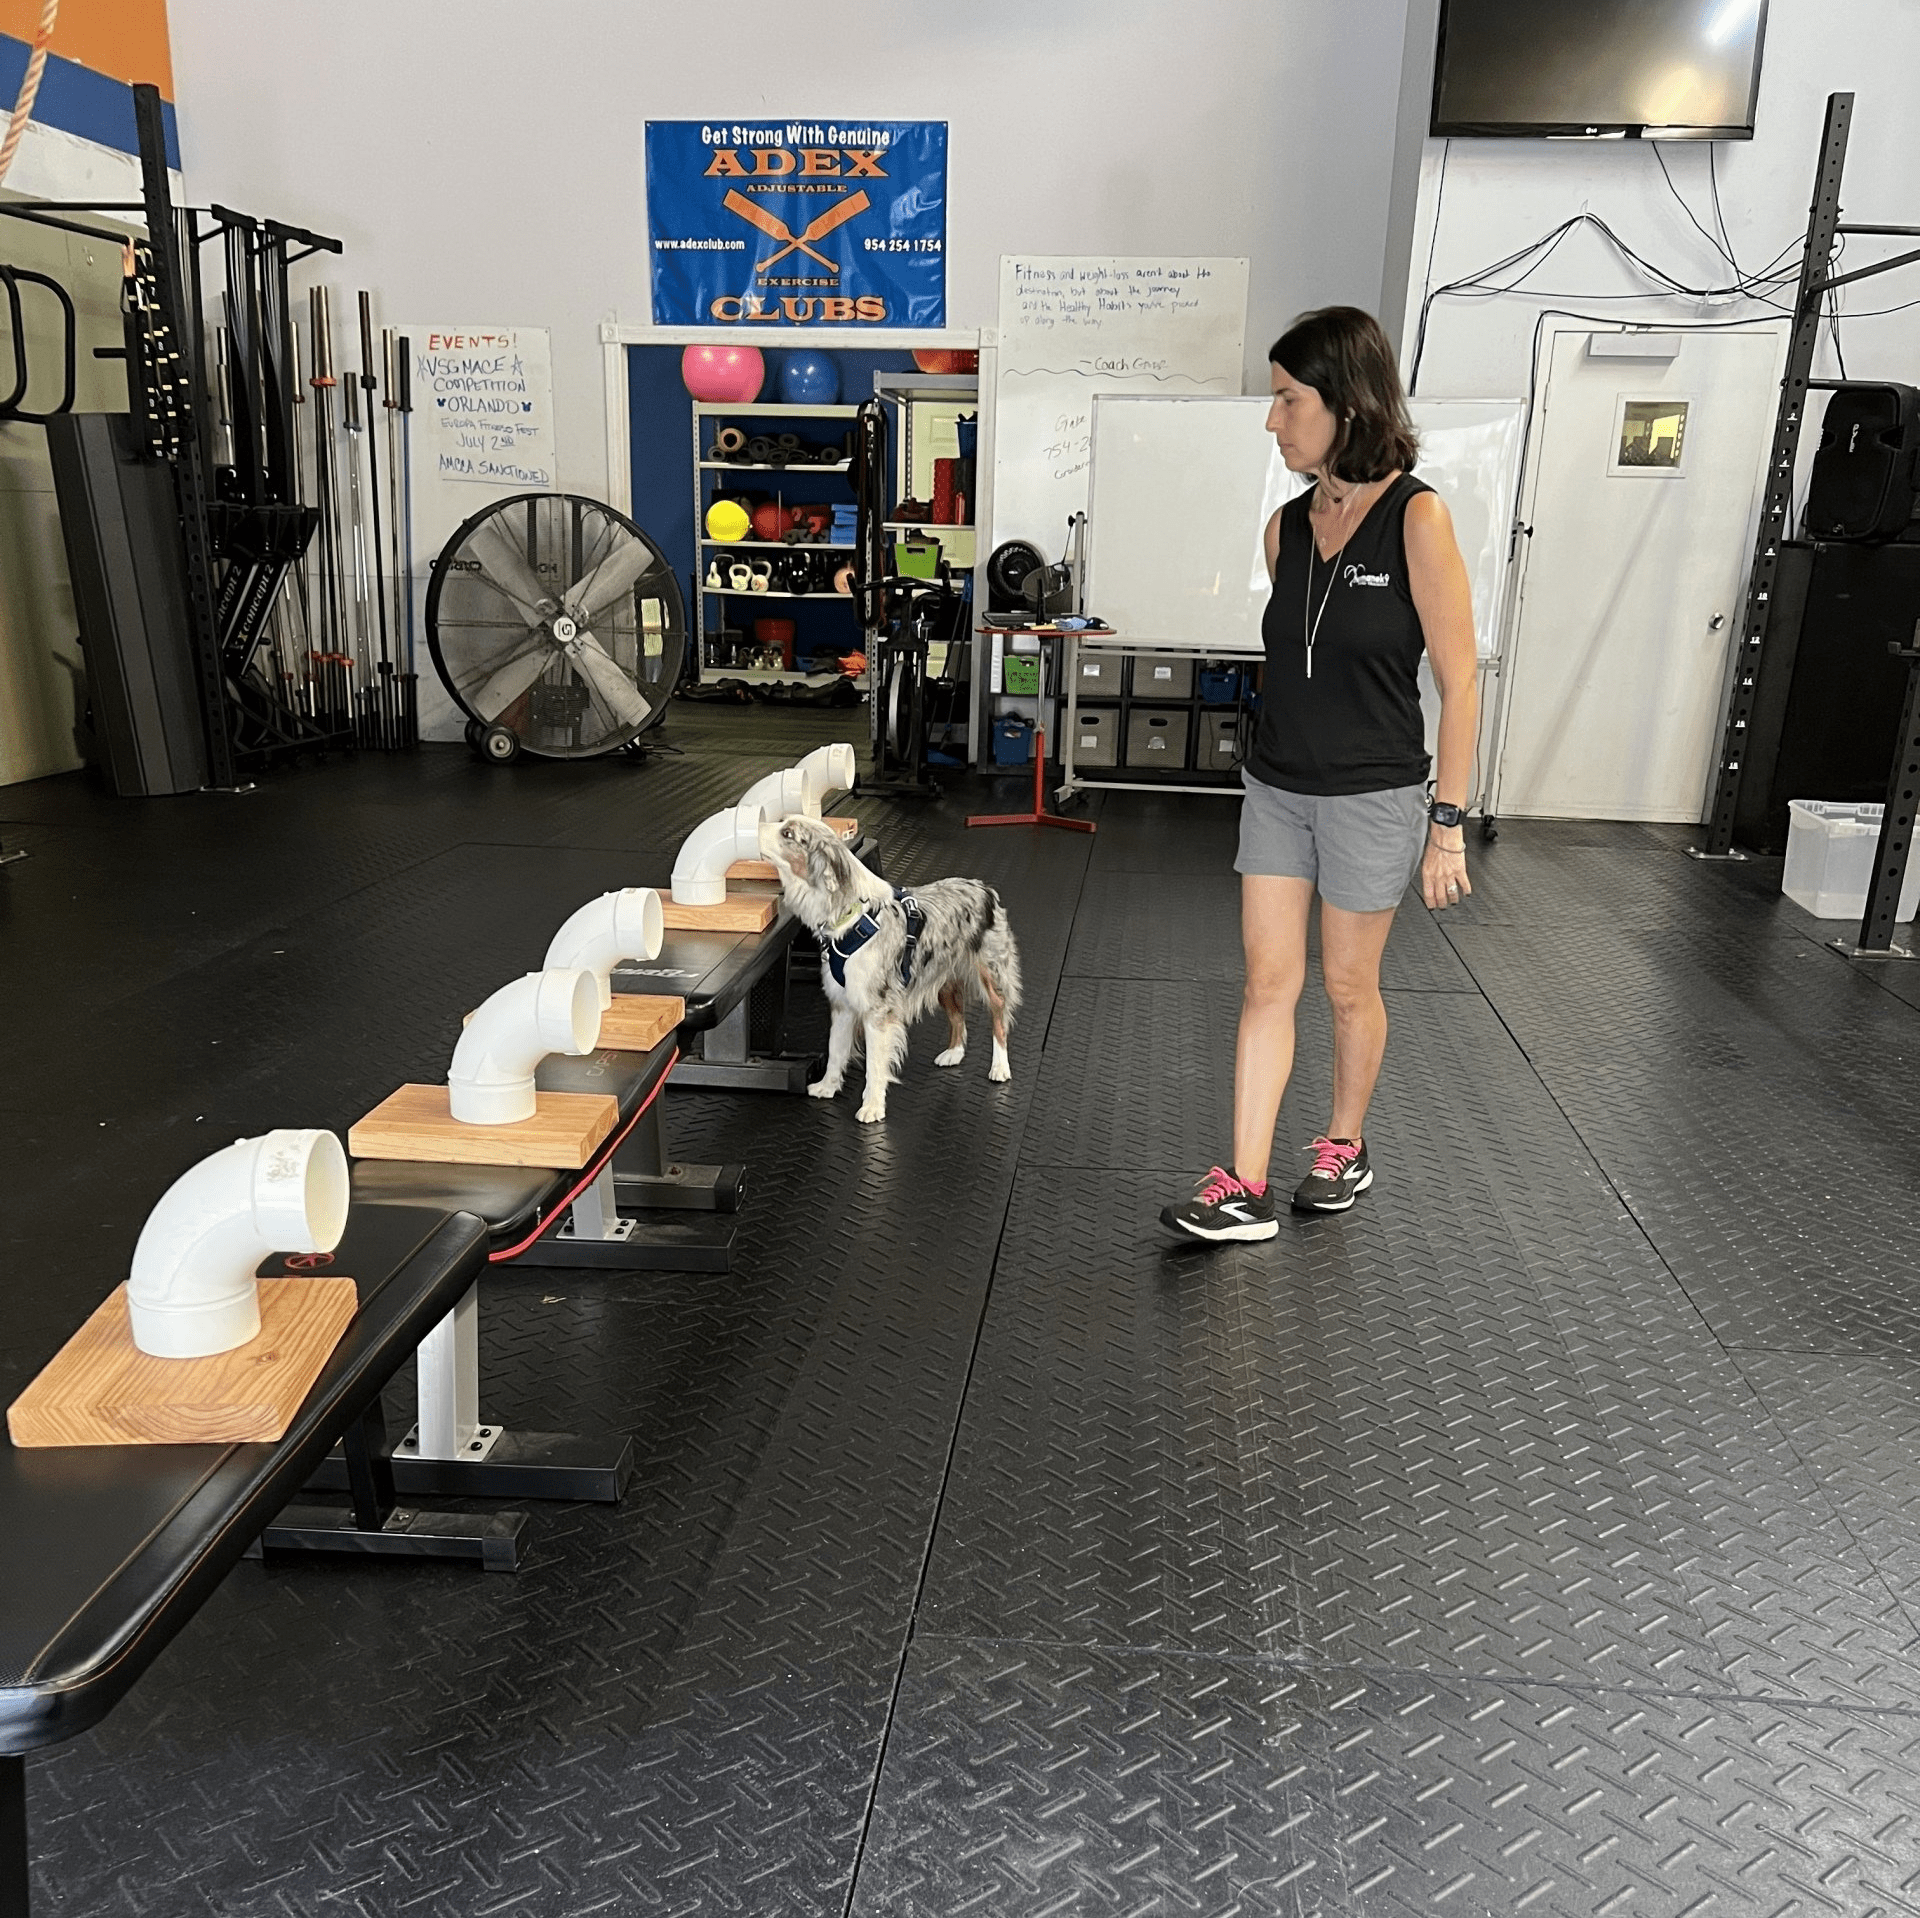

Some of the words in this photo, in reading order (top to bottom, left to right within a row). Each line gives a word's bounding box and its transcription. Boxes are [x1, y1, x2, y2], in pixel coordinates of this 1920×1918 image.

[702, 125, 728, 145] Get
[732, 125, 783, 147] Strong
[786, 124, 825, 145] With
[828, 126, 890, 146] Genuine
[703, 148, 890, 178] ADEX
[746, 184, 848, 193] ADJUSTABLE
[655, 237, 745, 250] www.adexclub.com
[864, 238, 886, 251] 954
[889, 239, 910, 252] 254
[914, 239, 941, 252] 1754
[1015, 264, 1056, 280] Fitness
[1168, 269, 1190, 279] about
[757, 278, 839, 287] EXERCISE
[1147, 286, 1180, 298] journey
[710, 296, 887, 322] CLUBS
[429, 332, 517, 350] EVENTS!
[462, 355, 506, 375] MACE
[1095, 357, 1129, 371] Coach
[448, 395, 519, 414] ORLANDO
[456, 432, 485, 453] JULY
[1043, 436, 1091, 460] 754-2
[478, 460, 549, 484] SANCTIONED
[232, 565, 242, 576] 2
[243, 574, 270, 632] concept
[265, 564, 274, 575] 2
